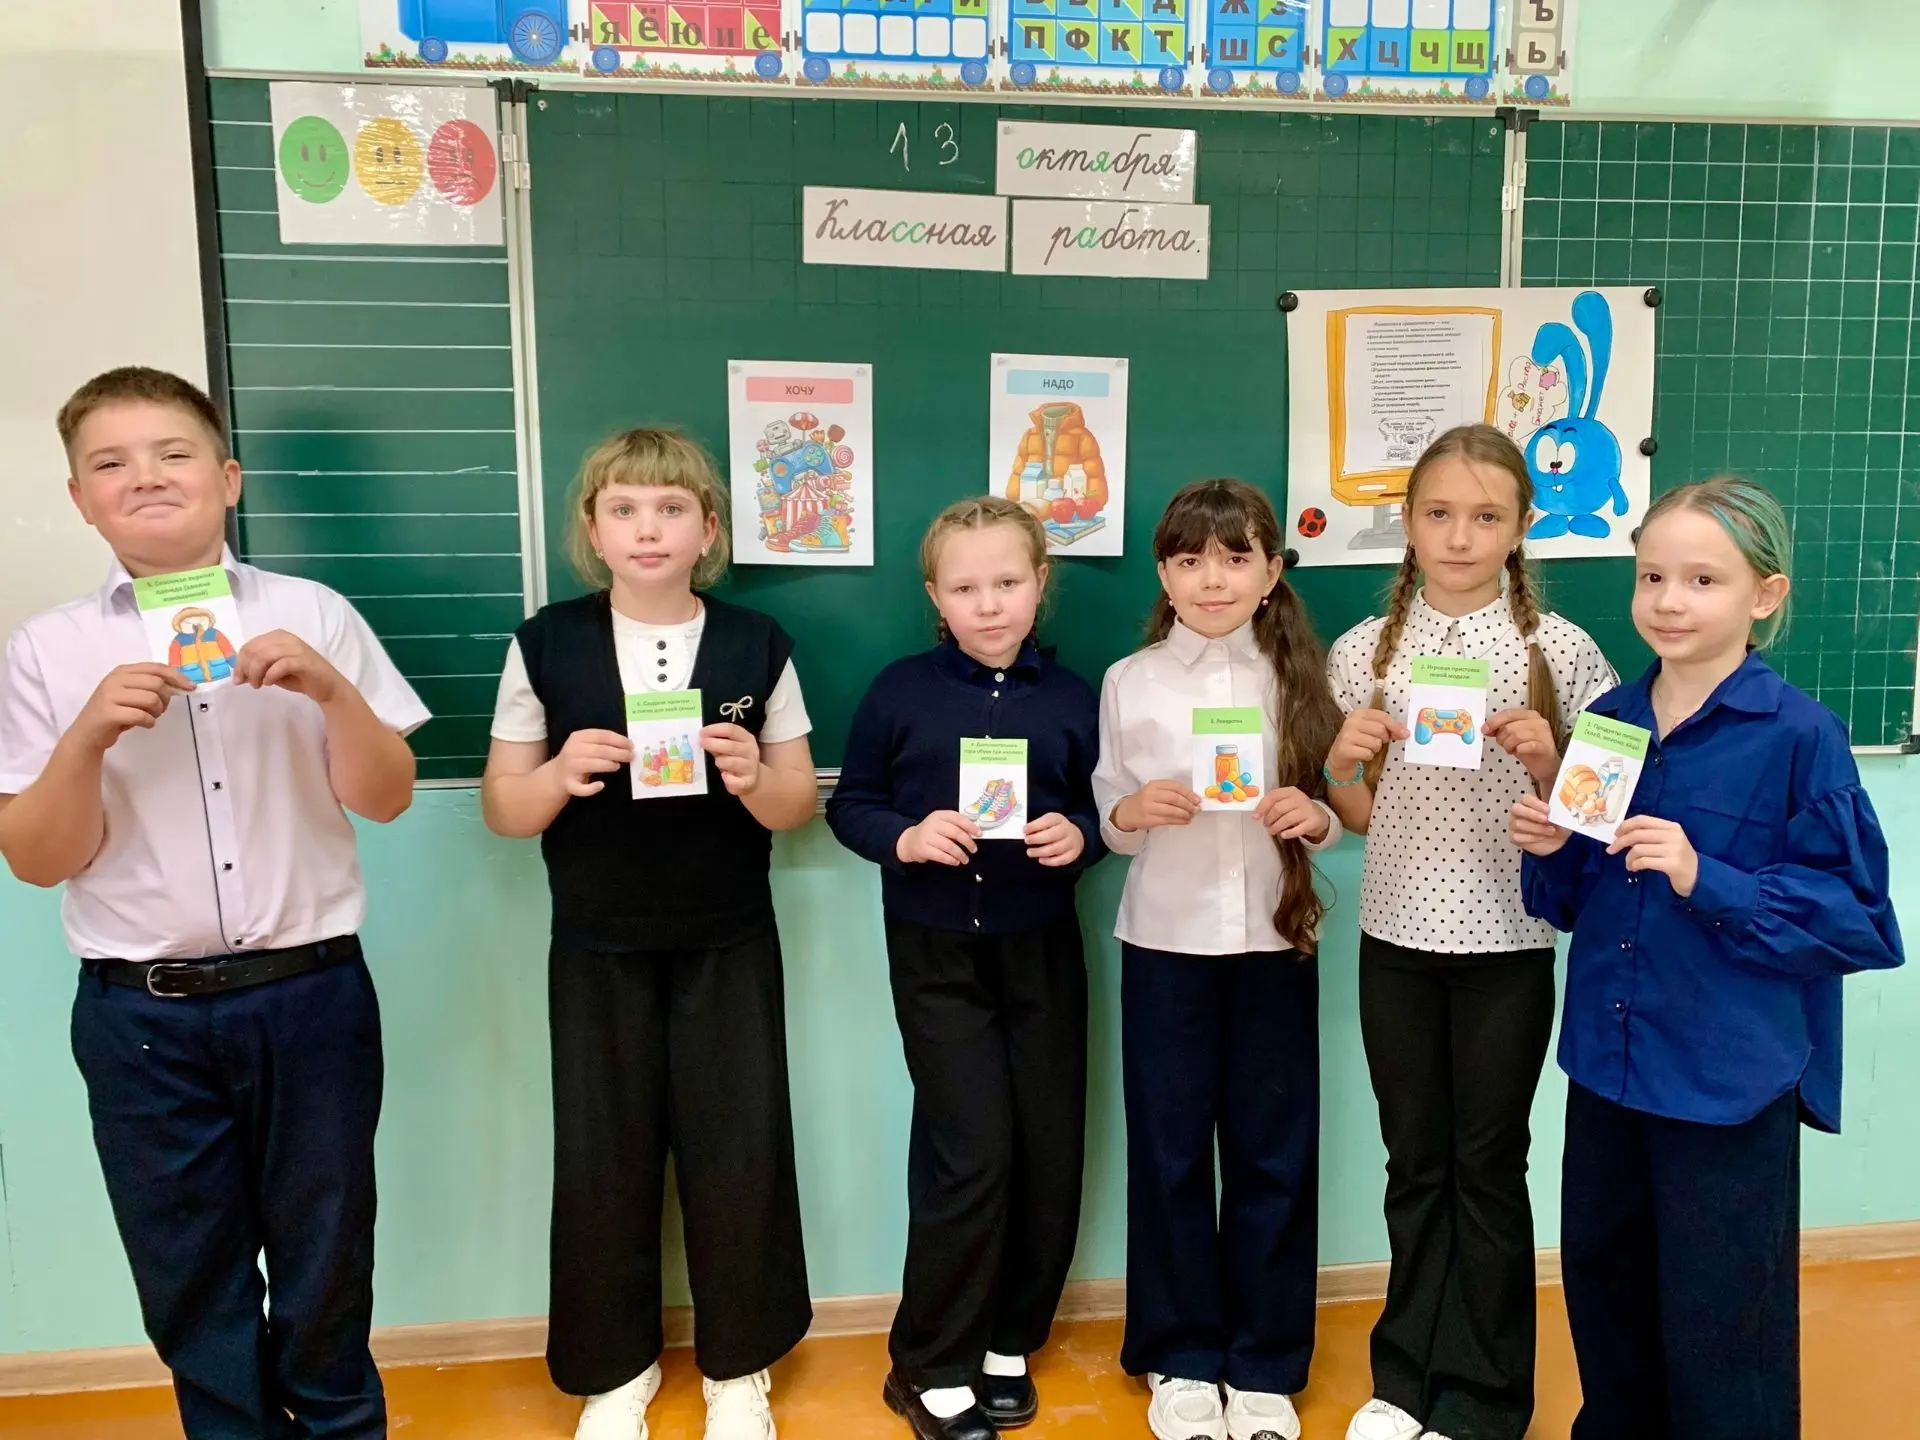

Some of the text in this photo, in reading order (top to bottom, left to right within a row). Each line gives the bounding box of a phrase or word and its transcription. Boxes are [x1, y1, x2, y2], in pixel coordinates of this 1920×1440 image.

[1024, 26, 1174, 53] П Ф К Т
[1219, 35, 1288, 61] Ш С
[1337, 38, 1485, 69] Х Ц Ч Щ
[1016, 134, 1181, 192] октября.
[815, 199, 1202, 266] Классная работа.
[784, 384, 816, 396] ХОЧУ
[1042, 378, 1075, 390] НАДО
